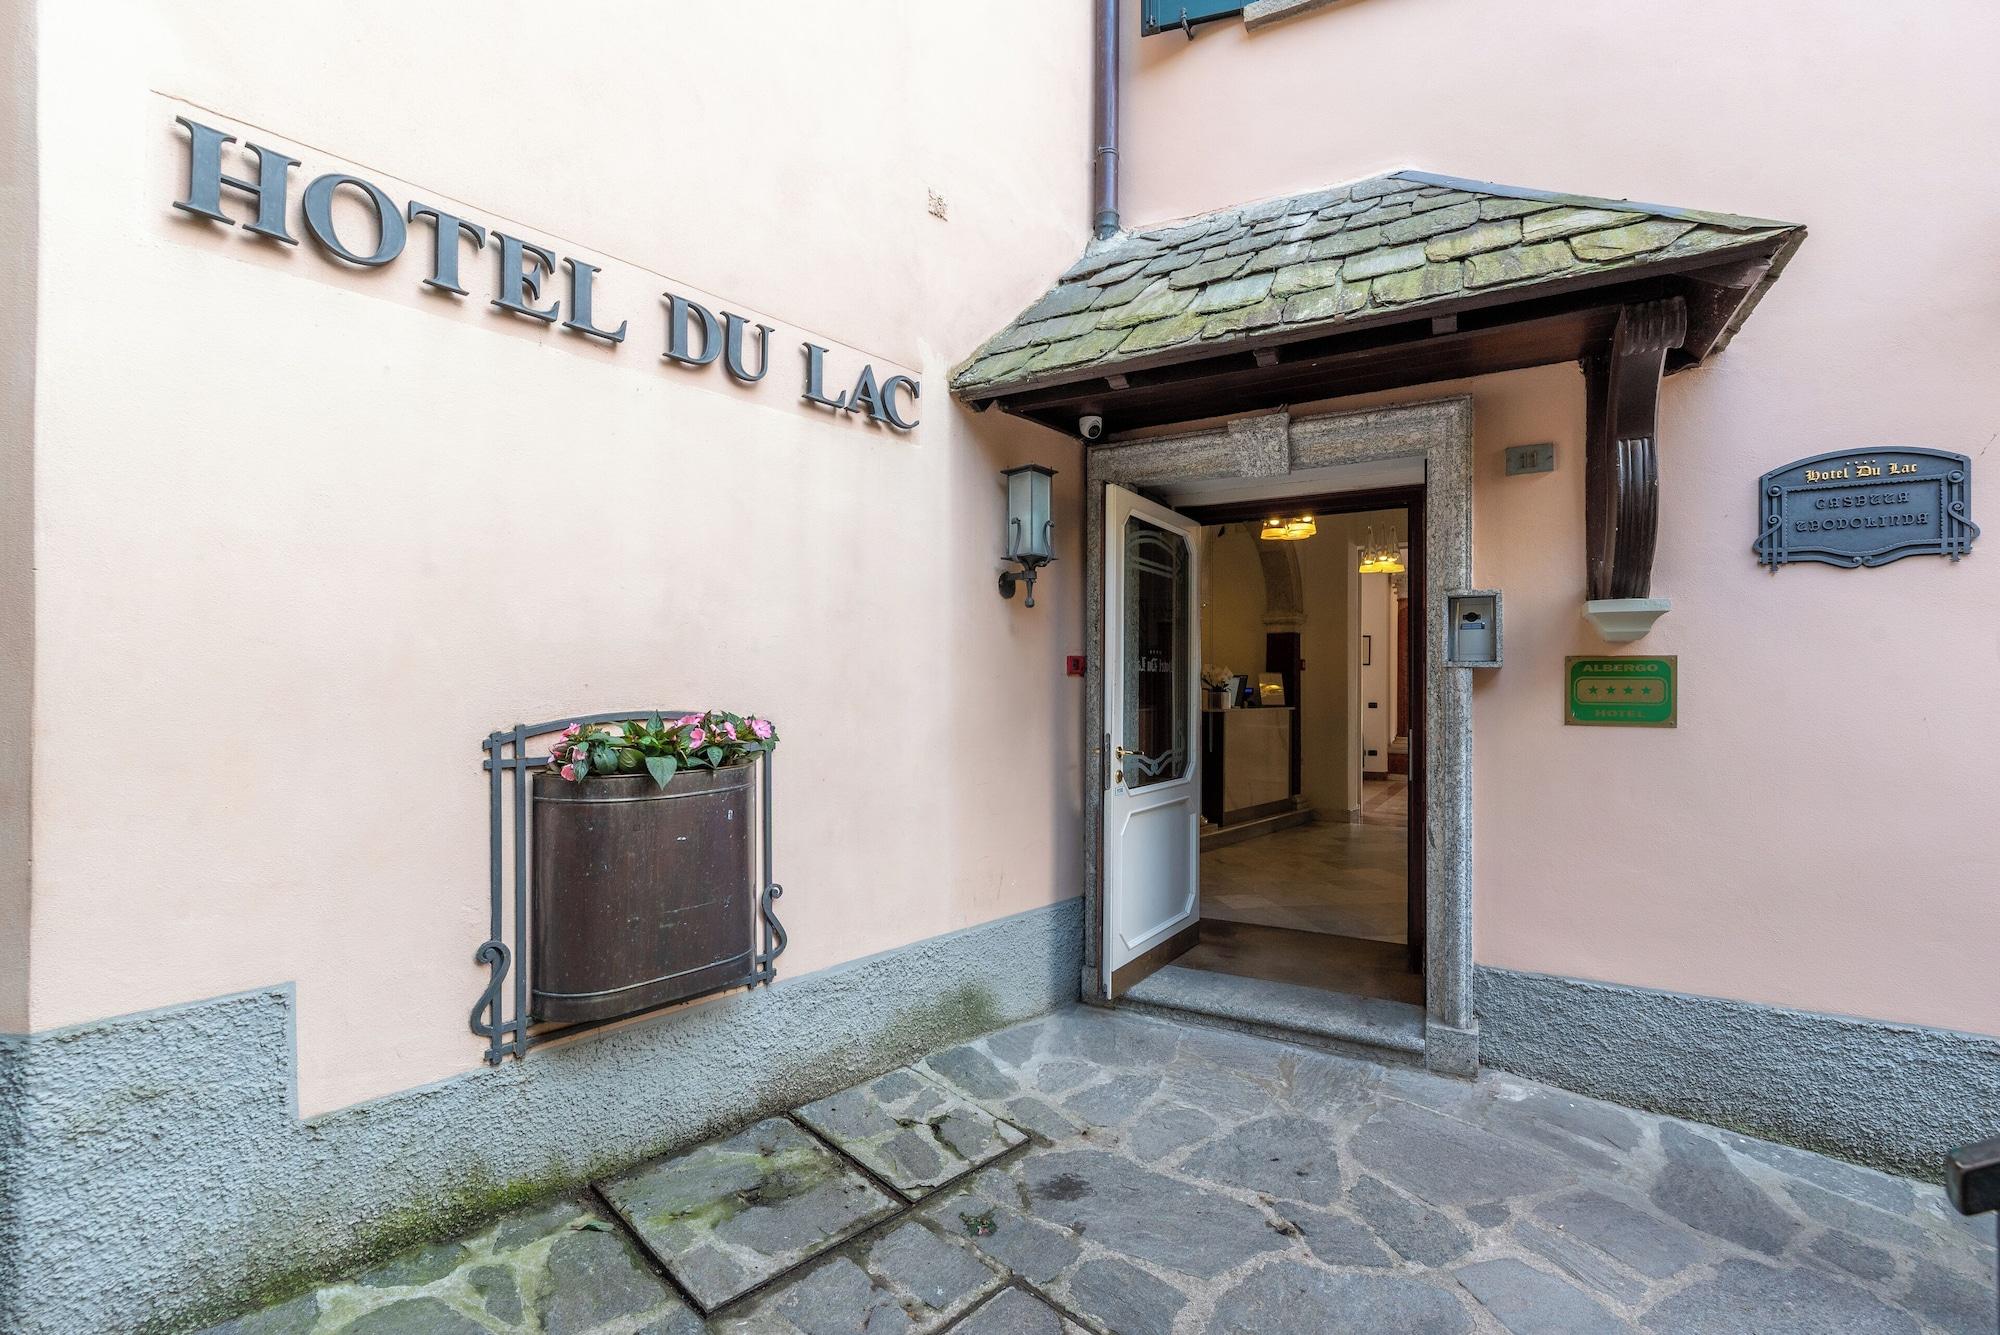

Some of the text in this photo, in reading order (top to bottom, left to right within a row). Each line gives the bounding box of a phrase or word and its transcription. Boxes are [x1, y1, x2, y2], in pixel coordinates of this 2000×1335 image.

[173, 115, 920, 430] HOTEL DU LAC
[1805, 462, 1918, 483] Hotel Du Lac
[1583, 663, 1659, 673] ALBERGO
[1594, 709, 1647, 719] HOTEL
